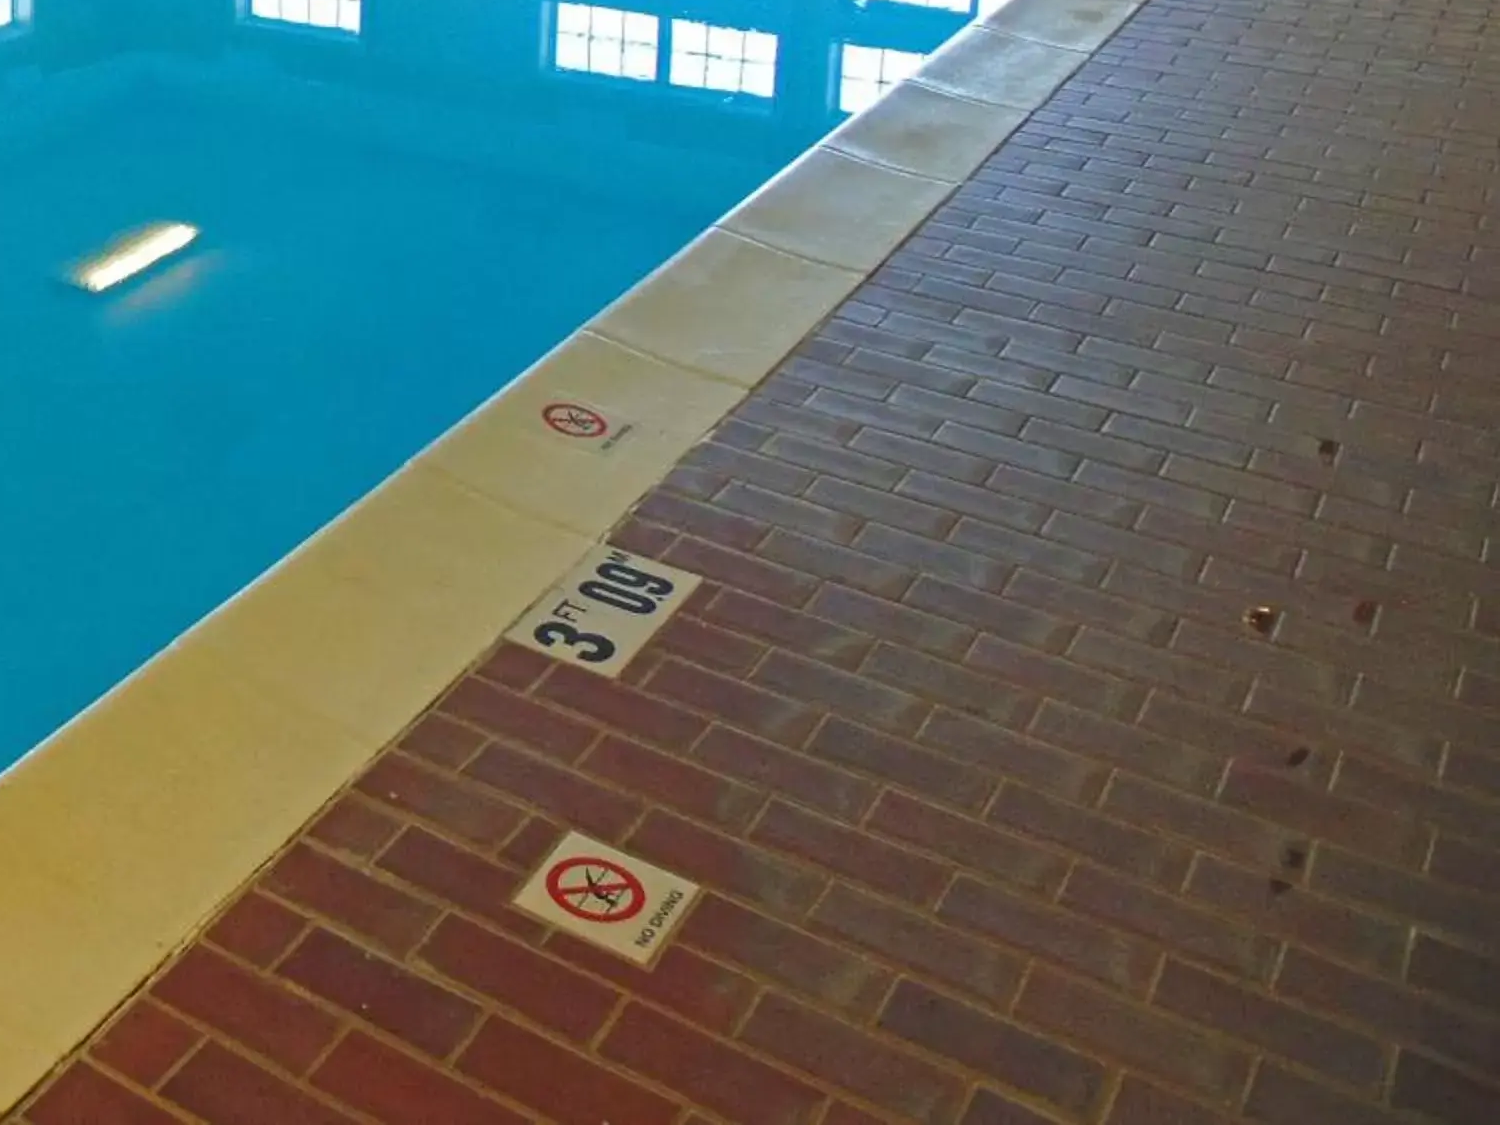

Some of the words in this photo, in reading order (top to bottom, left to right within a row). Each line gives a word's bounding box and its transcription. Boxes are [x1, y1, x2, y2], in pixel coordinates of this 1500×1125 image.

[552, 598, 588, 623] FT
[578, 562, 675, 614] 09
[533, 621, 616, 663] 3
[634, 928, 656, 948] NO
[648, 889, 684, 928] DIVING
